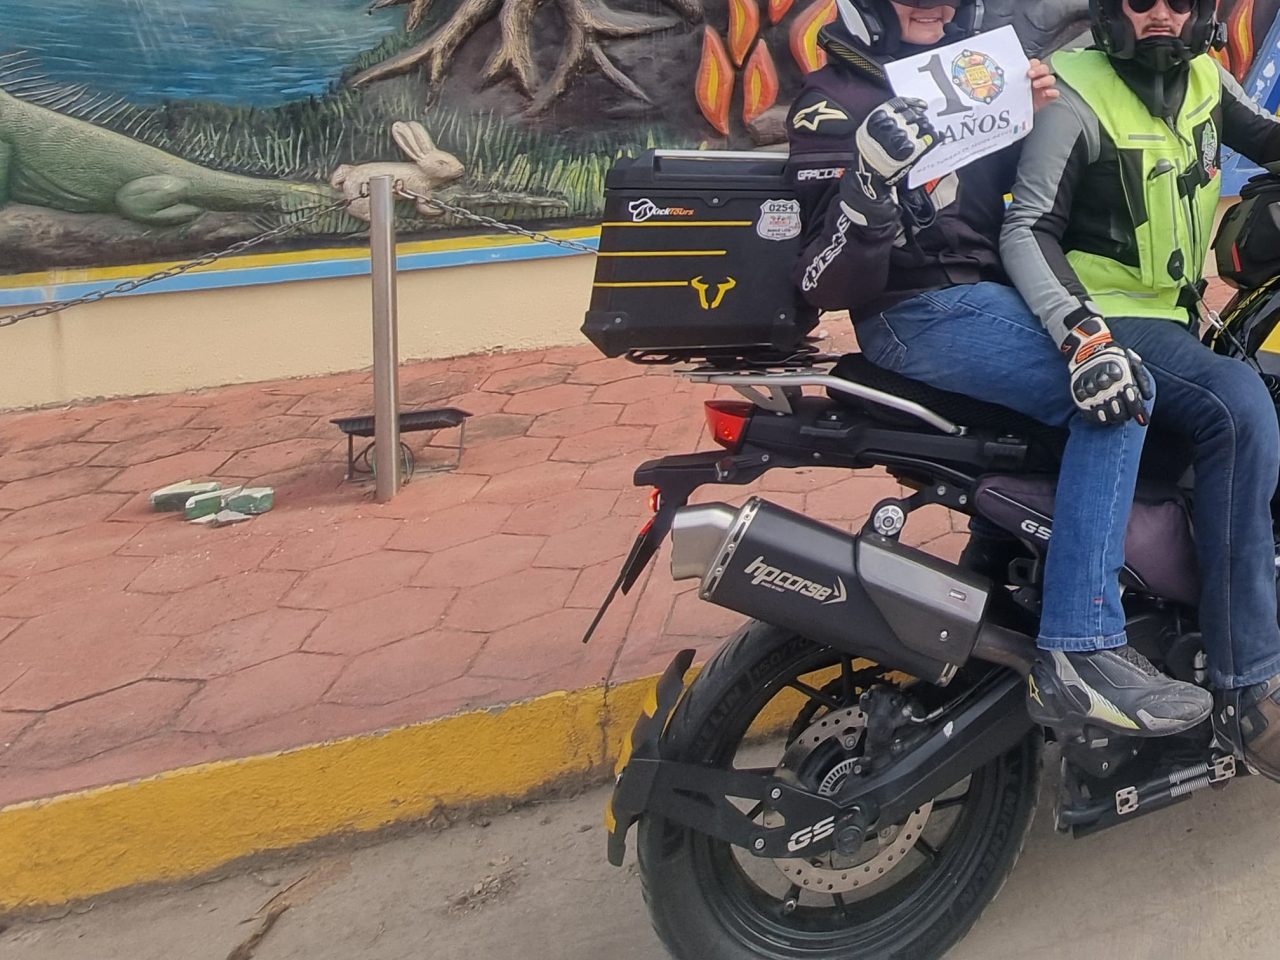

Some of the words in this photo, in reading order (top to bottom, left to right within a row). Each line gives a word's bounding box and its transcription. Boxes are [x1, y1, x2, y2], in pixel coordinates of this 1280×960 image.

[768, 203, 794, 212] 0254
[1020, 519, 1053, 540] GS
[787, 815, 835, 852] GS
